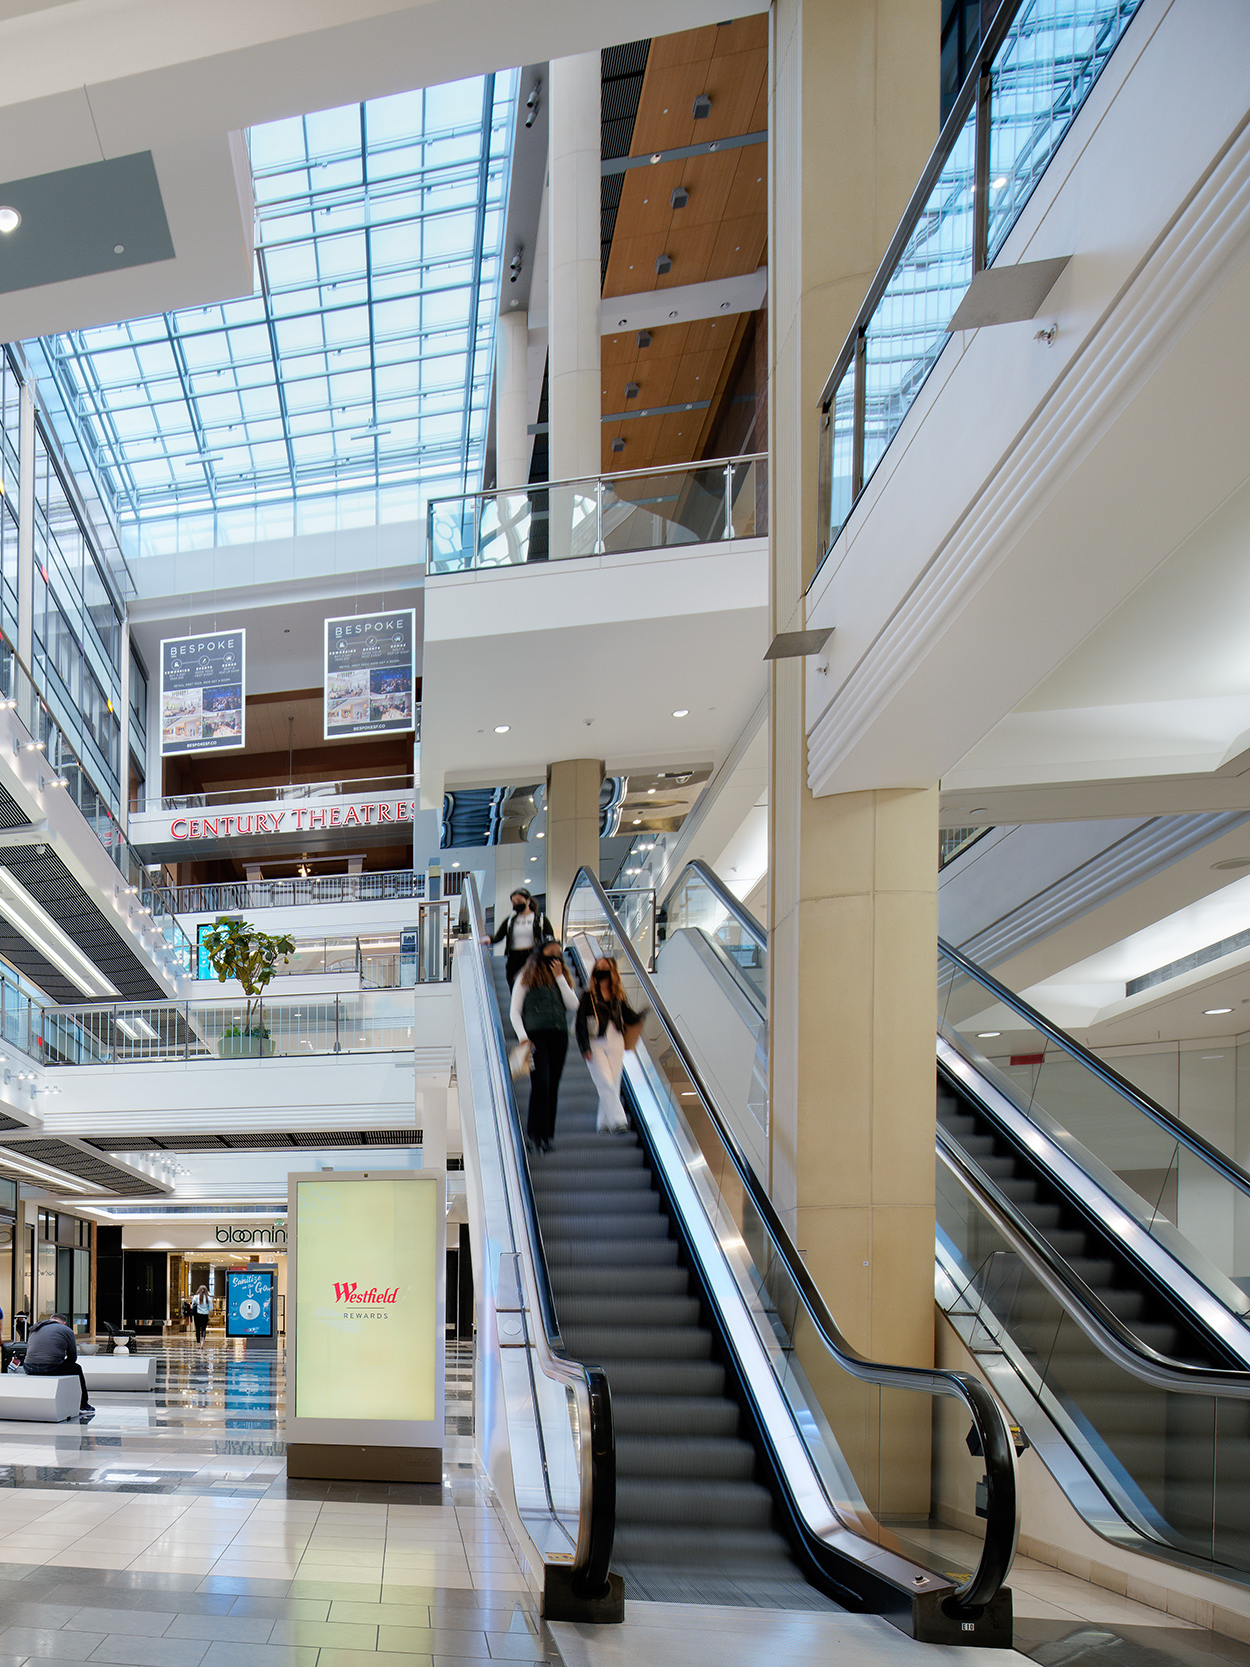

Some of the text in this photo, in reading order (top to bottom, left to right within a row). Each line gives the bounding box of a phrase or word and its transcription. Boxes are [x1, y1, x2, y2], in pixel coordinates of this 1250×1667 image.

[335, 619, 404, 636] BESPOKE
[170, 639, 235, 656] BESPOKE
[170, 812, 285, 840] CENTURY
[215, 1225, 288, 1244] bloomin
[332, 1281, 400, 1304] Westfield
[343, 1312, 389, 1320] REWARDS
